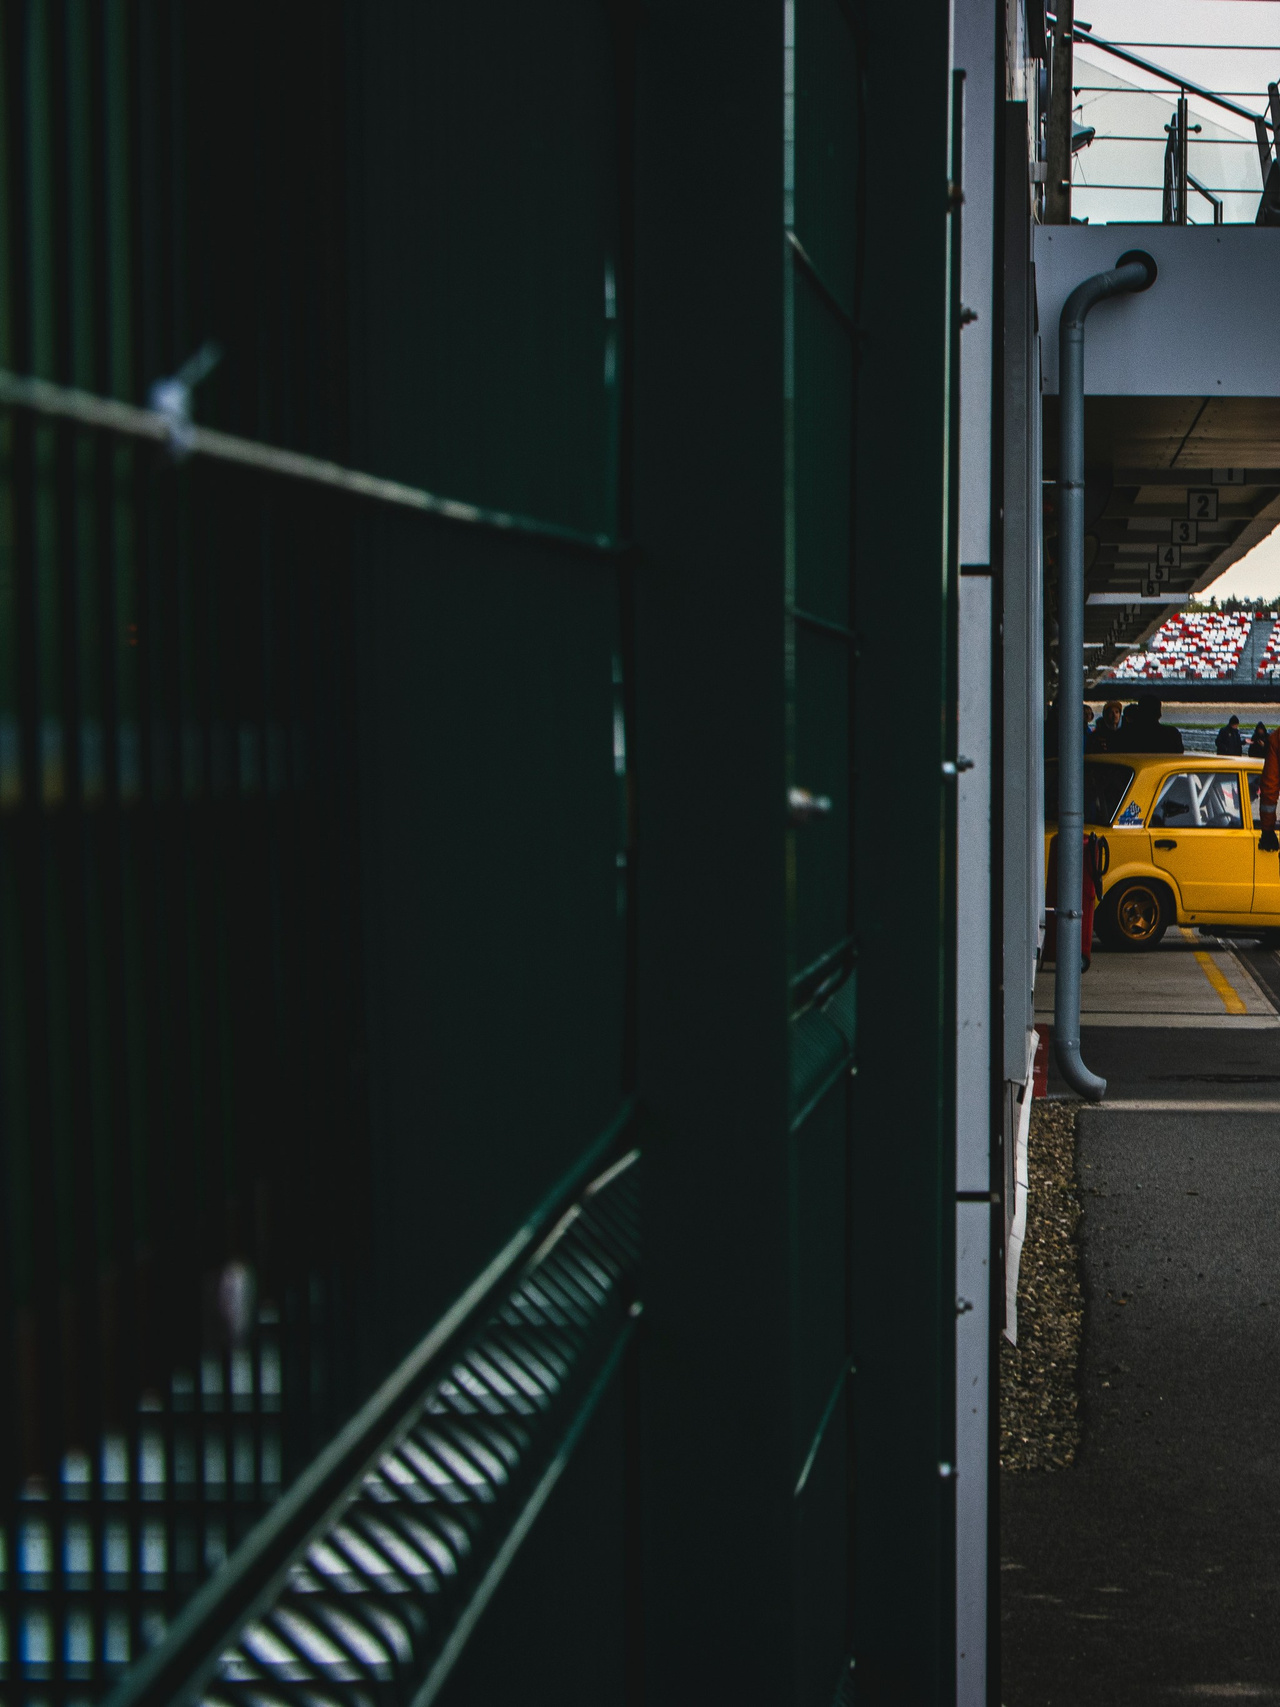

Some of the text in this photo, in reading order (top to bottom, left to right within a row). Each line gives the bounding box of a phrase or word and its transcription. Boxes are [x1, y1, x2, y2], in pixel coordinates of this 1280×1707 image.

[1197, 495, 1209, 517] 2
[1179, 522, 1190, 542] 3
[1164, 547, 1175, 565] 4
[1155, 565, 1163, 580] 5
[1146, 581, 1155, 594] 6
